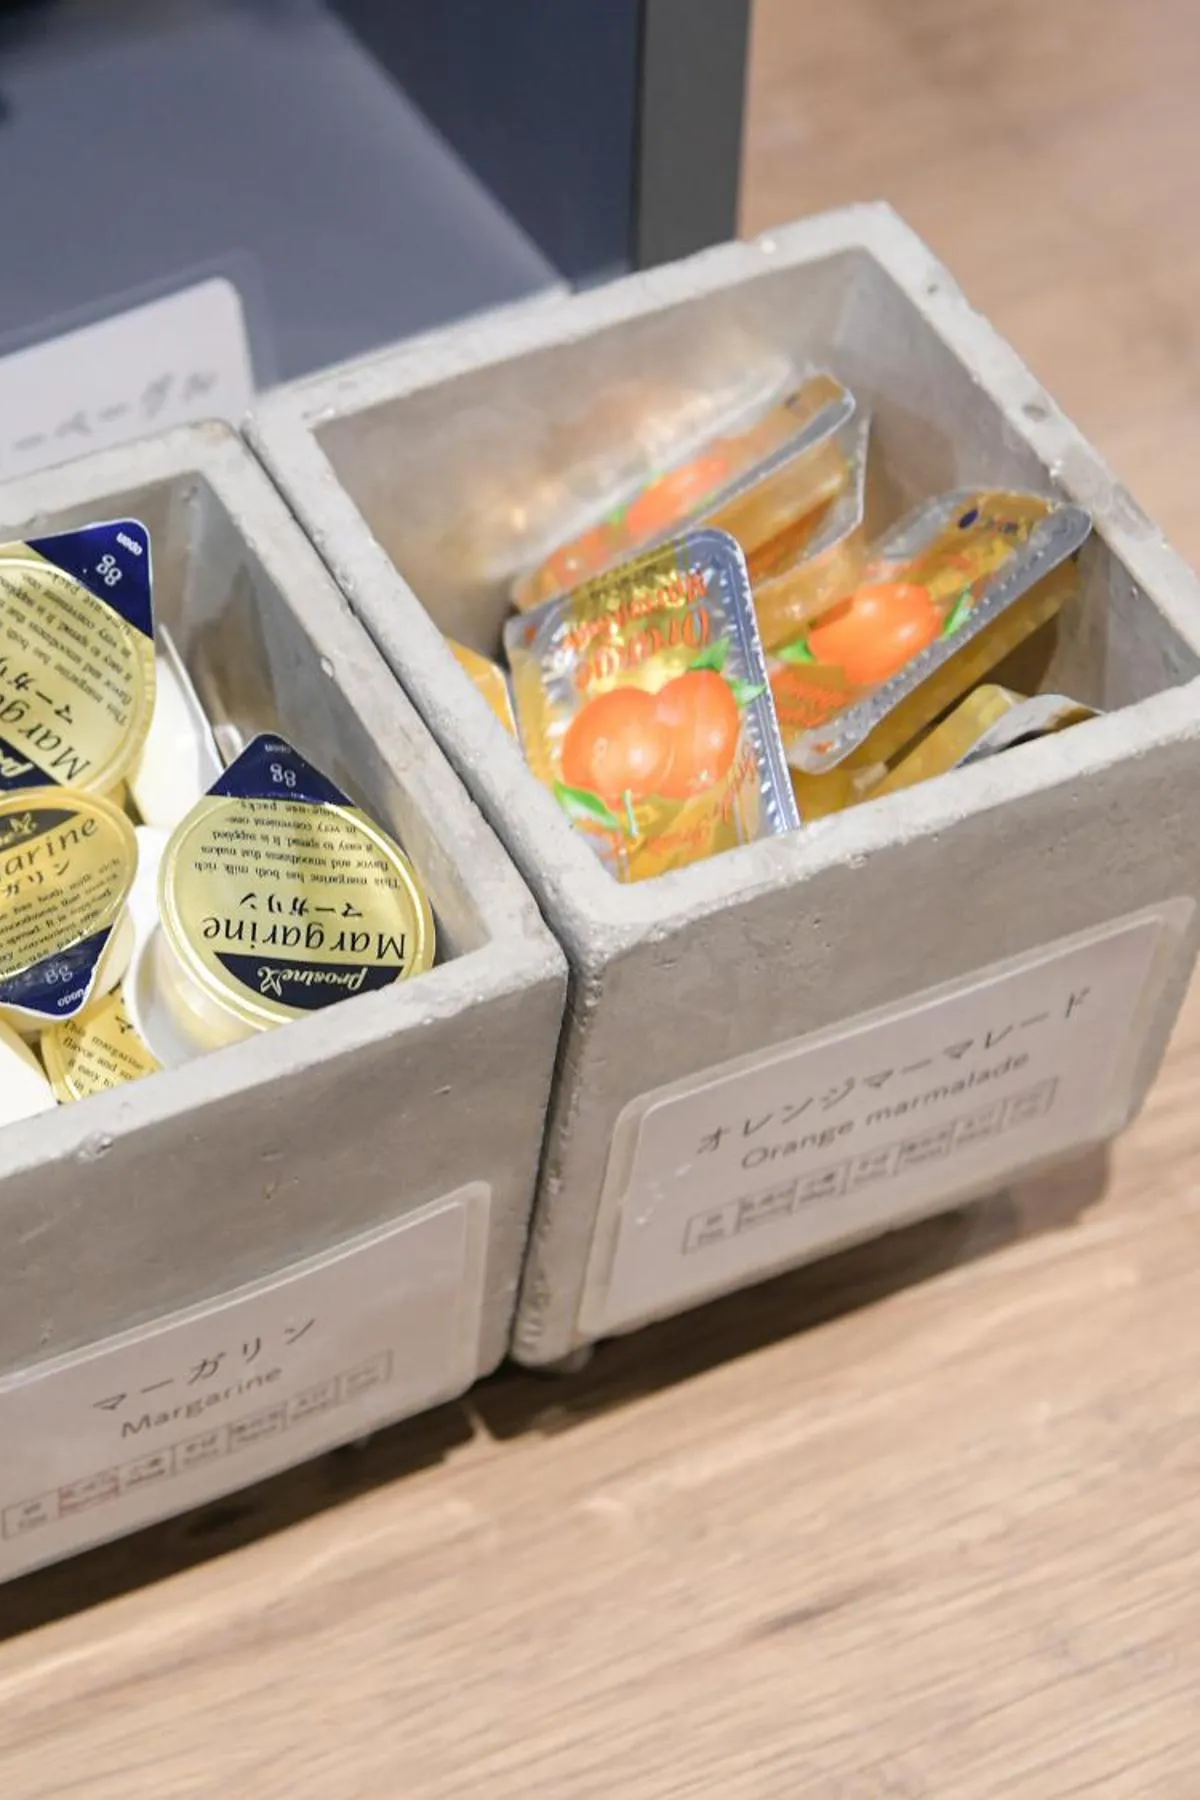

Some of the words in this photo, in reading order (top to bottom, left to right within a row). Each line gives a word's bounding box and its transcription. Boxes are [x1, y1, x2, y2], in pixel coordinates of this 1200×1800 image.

[95, 554, 122, 586] 8g
[270, 763, 297, 788] 8g
[317, 821, 341, 834] very
[212, 829, 257, 842] supplied
[200, 845, 237, 857] makes
[241, 847, 262, 861] that
[194, 860, 217, 872] rich
[224, 862, 249, 876] milk
[331, 858, 351, 870] and
[255, 866, 280, 881] both
[286, 870, 305, 884] has
[310, 872, 368, 885] margarine
[239, 892, 363, 918] マーガリン
[202, 916, 406, 961] Margarine
[43, 963, 74, 985] 8g
[696, 986, 1091, 1155] オレンジマーマレード
[741, 1117, 855, 1171] Orange
[866, 1051, 1031, 1126] marmalade
[92, 1317, 316, 1411] マーガリン
[119, 1366, 283, 1439] Margarine
